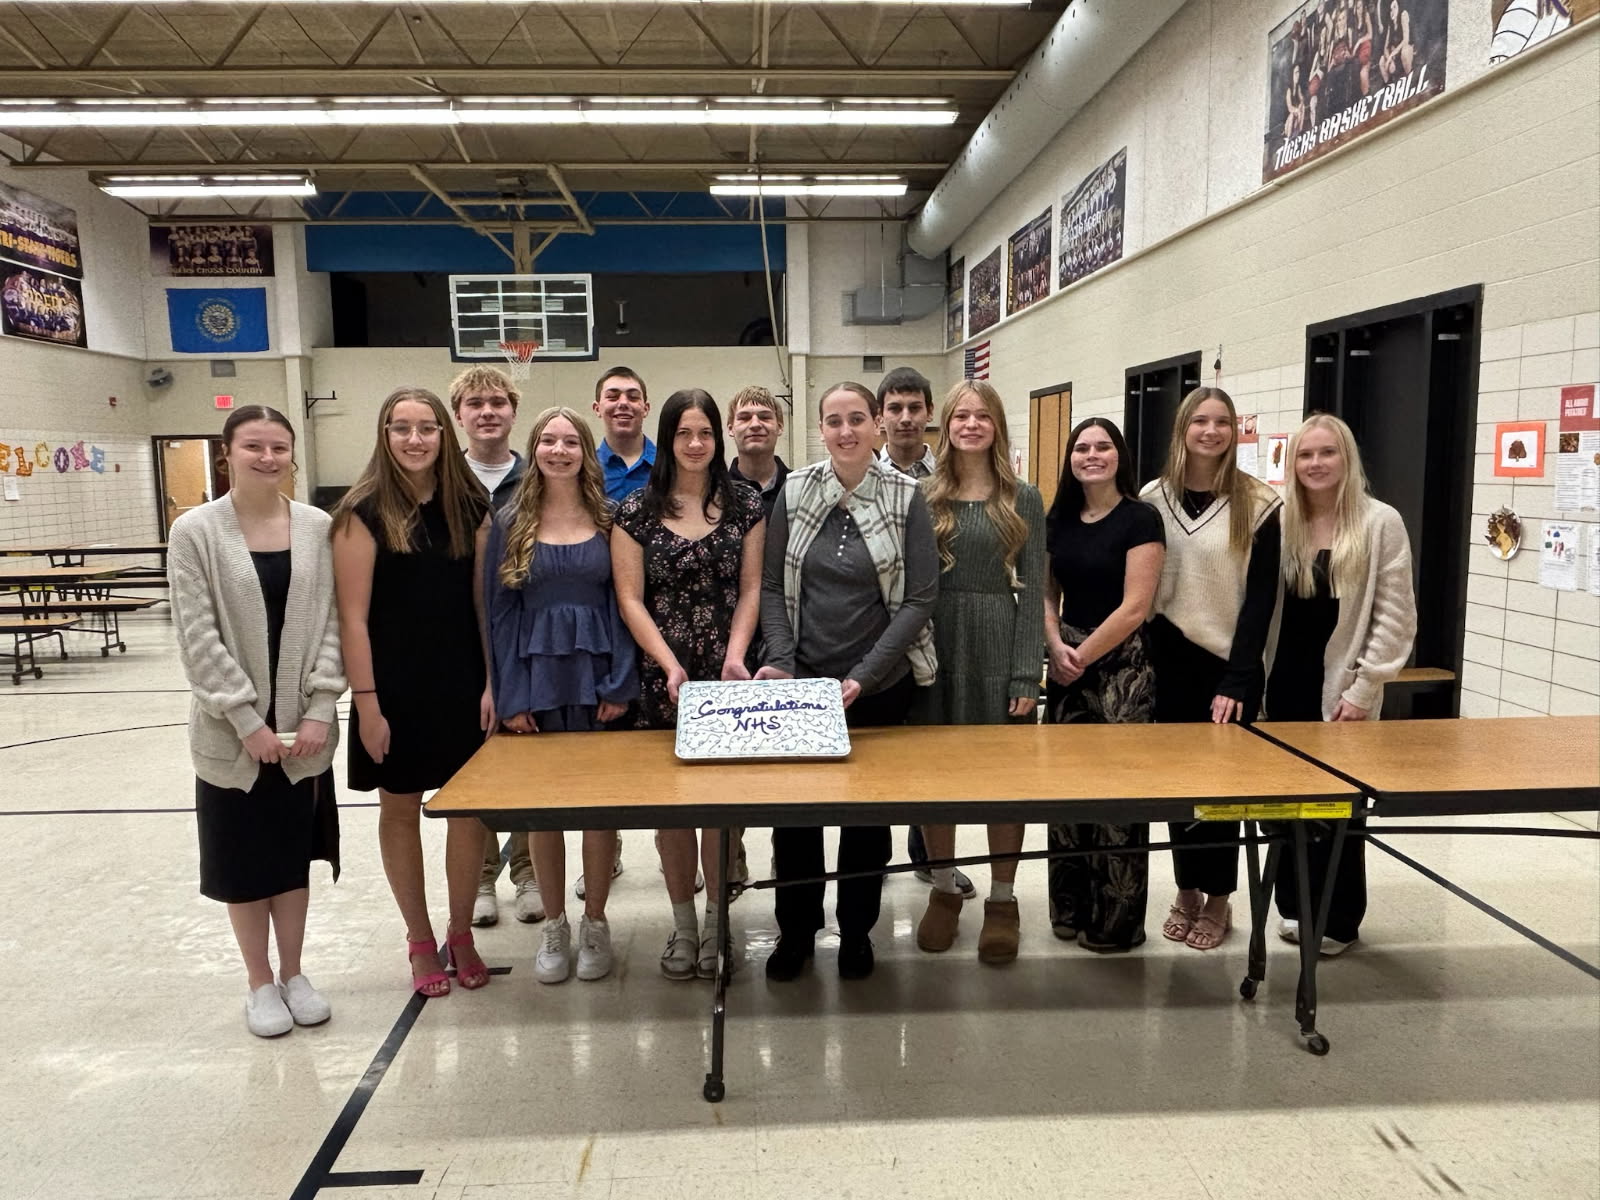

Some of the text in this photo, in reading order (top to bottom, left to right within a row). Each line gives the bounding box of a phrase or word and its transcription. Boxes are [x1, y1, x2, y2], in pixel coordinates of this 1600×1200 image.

[1274, 64, 1430, 171] TIGERS BASKETBALL
[690, 699, 828, 719] Congratulations
[733, 715, 782, 735] NHS
